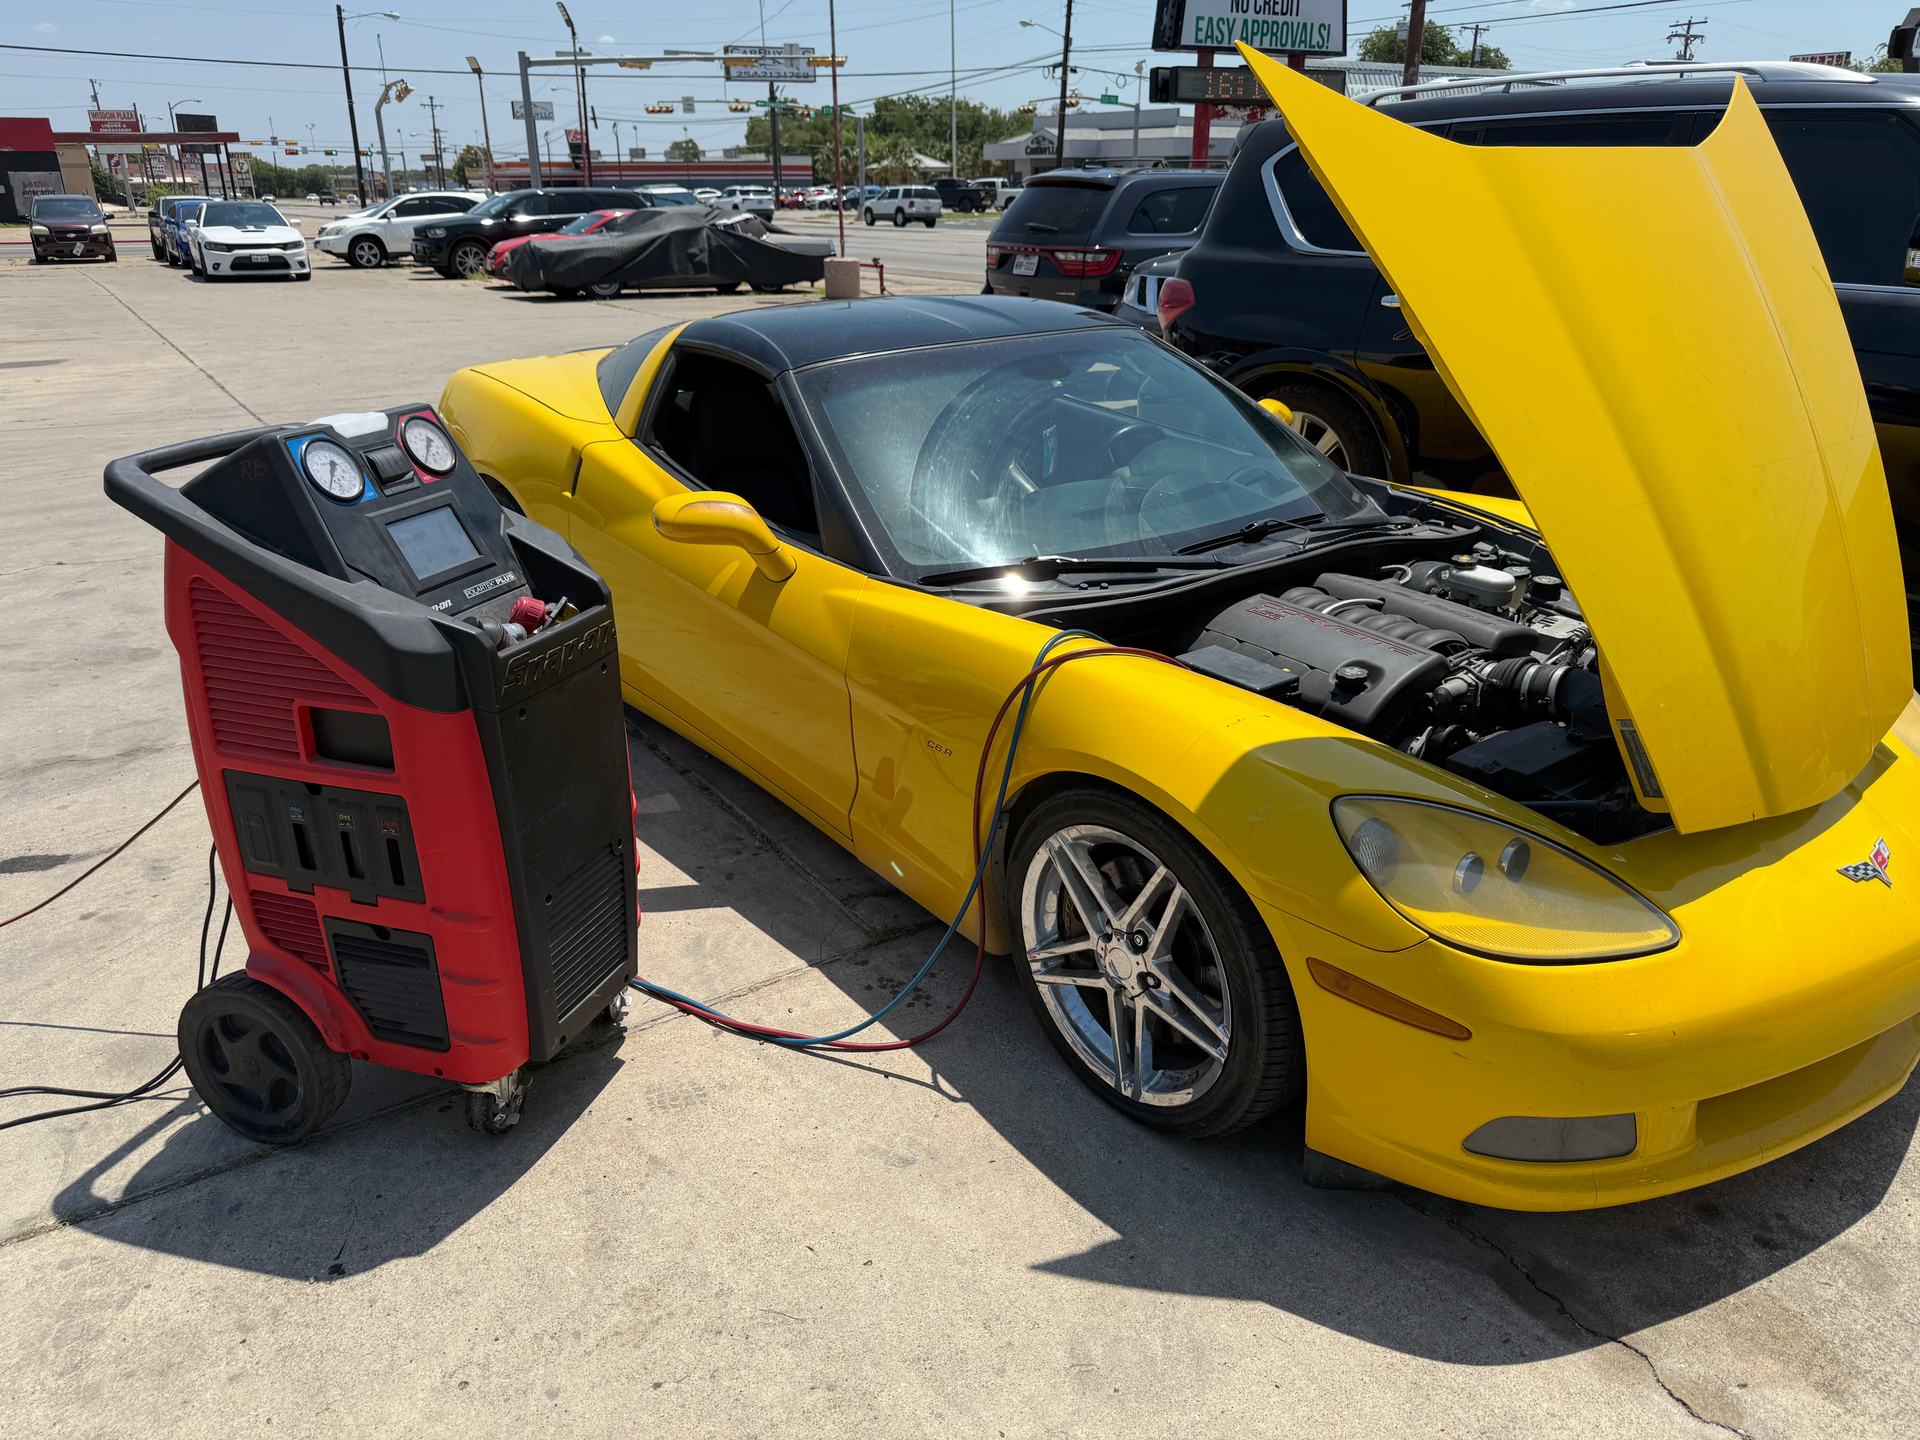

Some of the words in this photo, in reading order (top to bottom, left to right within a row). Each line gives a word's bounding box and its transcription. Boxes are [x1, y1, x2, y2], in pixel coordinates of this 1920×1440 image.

[1253, 0, 1301, 17] CREDIT
[1194, 16, 1236, 45] EASY
[1240, 19, 1331, 49] APPROVALS!
[90, 111, 116, 120] WISDOM
[116, 111, 135, 120] PLAZA
[240, 459, 268, 481] RB
[465, 580, 497, 598] POLARTEK
[495, 572, 515, 585] PLUS
[926, 740, 953, 757] C6.R
